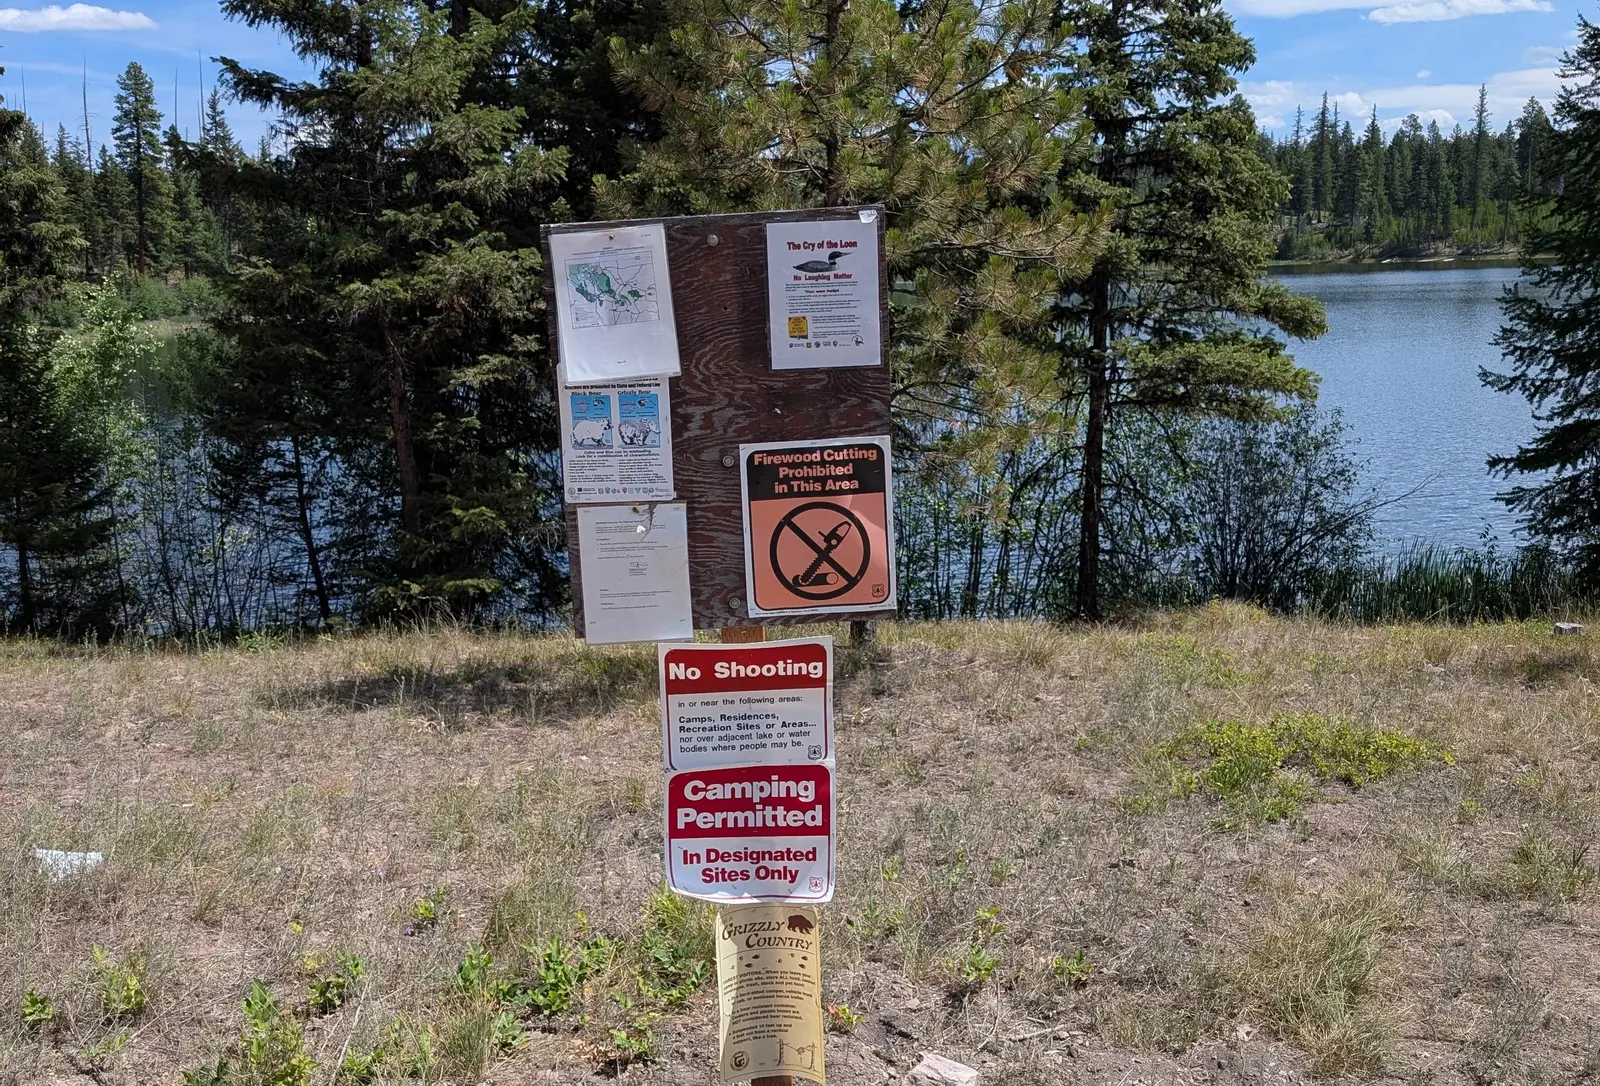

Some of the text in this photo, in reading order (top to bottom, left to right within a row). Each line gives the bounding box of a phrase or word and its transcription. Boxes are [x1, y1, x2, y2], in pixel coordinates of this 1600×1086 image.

[787, 240, 858, 251] The Cry of the Loon
[754, 448, 878, 466] Firewood Cutting
[779, 463, 854, 478] Prohibited
[774, 478, 859, 494] in This Area
[669, 659, 823, 680] No Shooting
[739, 696, 775, 706] following
[678, 712, 780, 724] Camps, Residences,
[679, 724, 732, 734] Recreation
[736, 722, 761, 732] Sites
[780, 720, 817, 729] Areas...
[718, 733, 753, 744] adjacent
[789, 730, 811, 738] water
[680, 739, 804, 754] bodies where people may be.
[684, 775, 816, 803] Camping
[677, 805, 823, 830] Permitted
[682, 847, 817, 865] In Designated
[701, 866, 800, 884] Sites Only
[722, 921, 785, 940] GRIZZLY
[745, 933, 812, 950] COUNTRY
